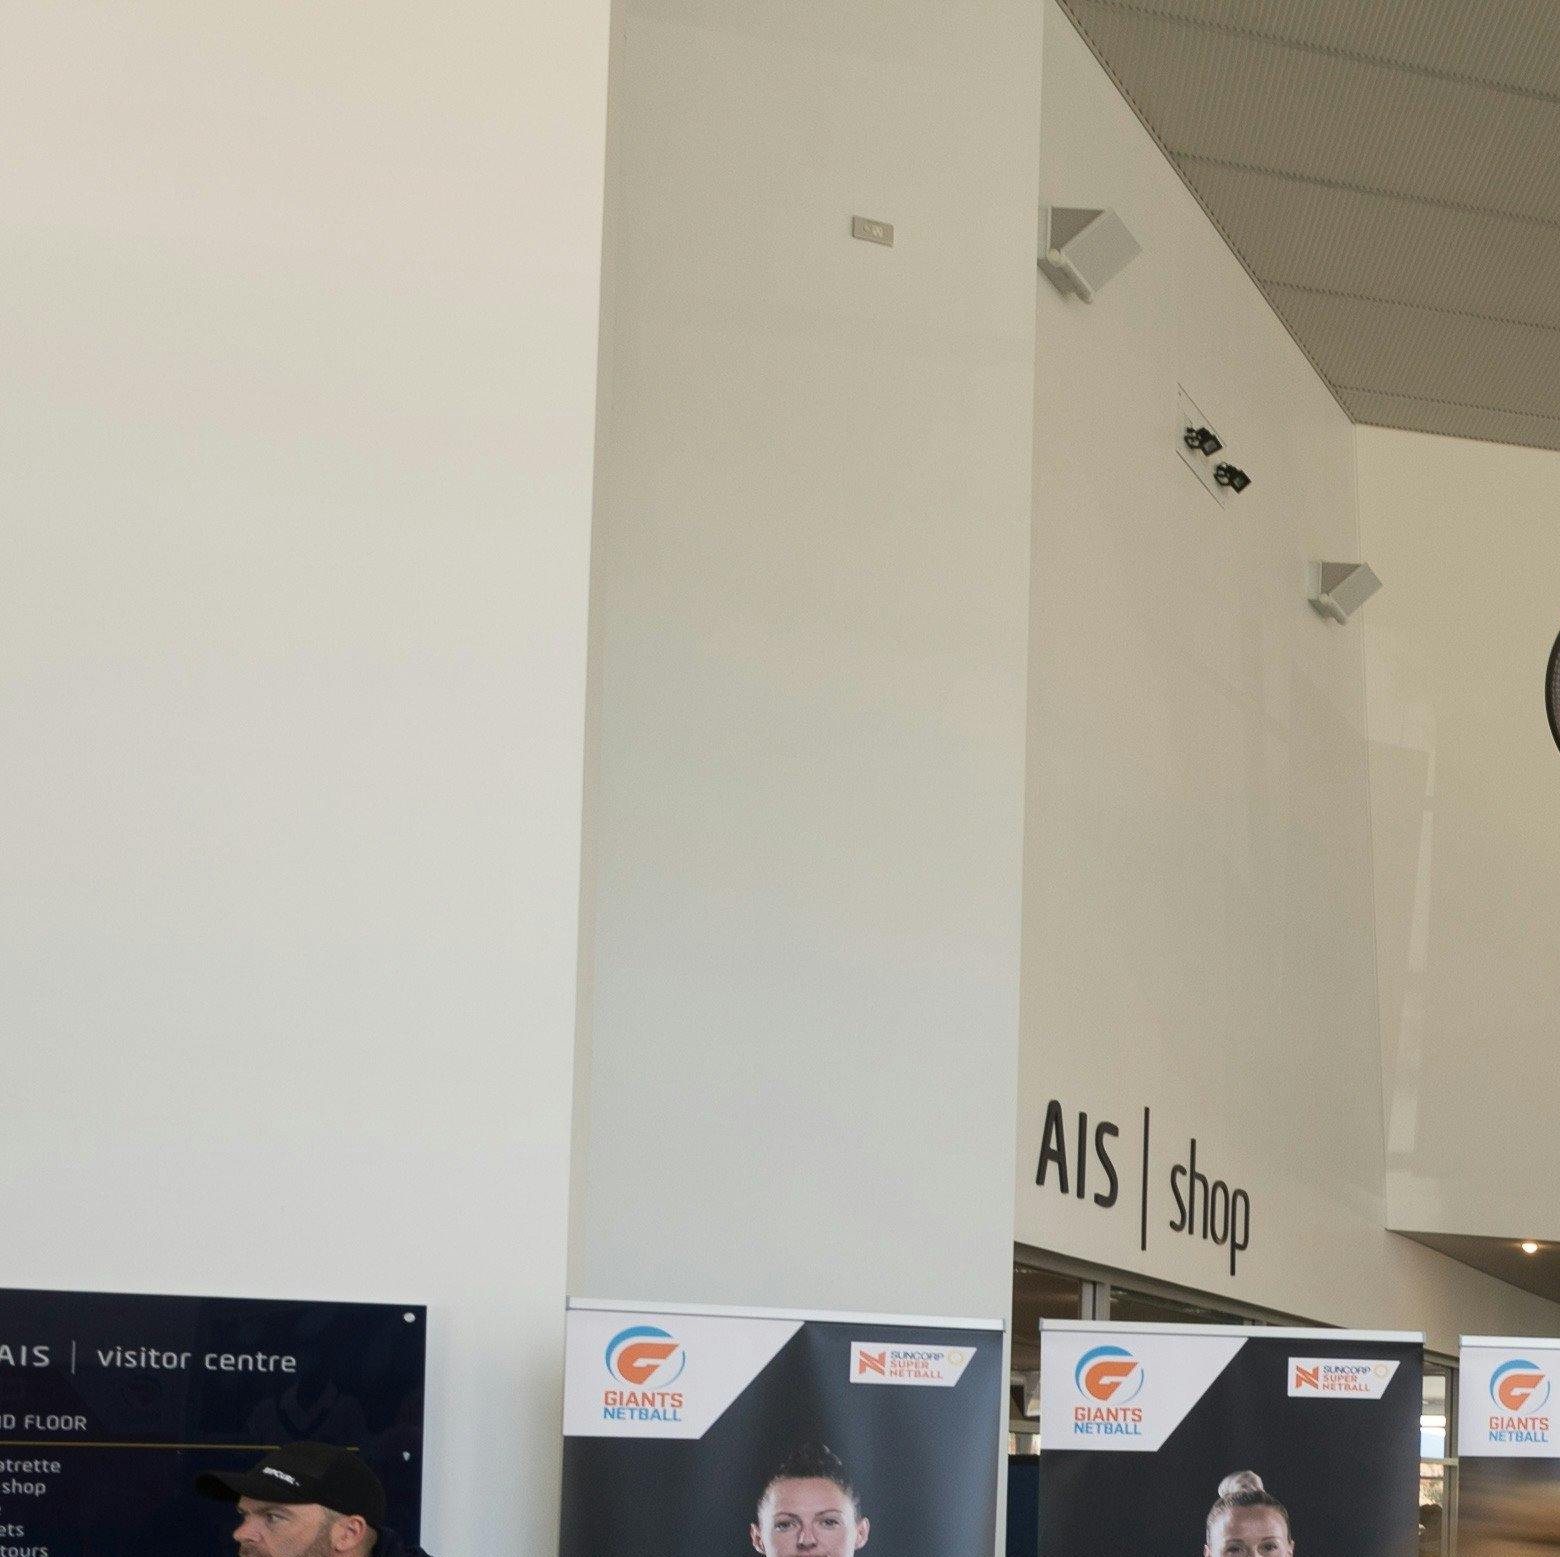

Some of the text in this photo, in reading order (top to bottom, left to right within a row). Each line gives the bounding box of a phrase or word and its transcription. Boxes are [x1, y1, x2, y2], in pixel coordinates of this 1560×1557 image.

[1035, 1099, 1250, 1276] AIS shop
[97, 1346, 191, 1369] visitor
[205, 1351, 297, 1373] centre
[891, 1369, 943, 1379] NETBALL
[604, 1390, 684, 1408] GIANTS
[603, 1406, 681, 1422] NETBALL
[1074, 1407, 1142, 1422] GIANTS
[0, 1414, 87, 1431] D FLOOR
[1074, 1421, 1141, 1436] NETBALL
[1489, 1416, 1549, 1432] GIANTS
[1488, 1430, 1548, 1443] NETBALL
[2, 1478, 46, 1497] shop
